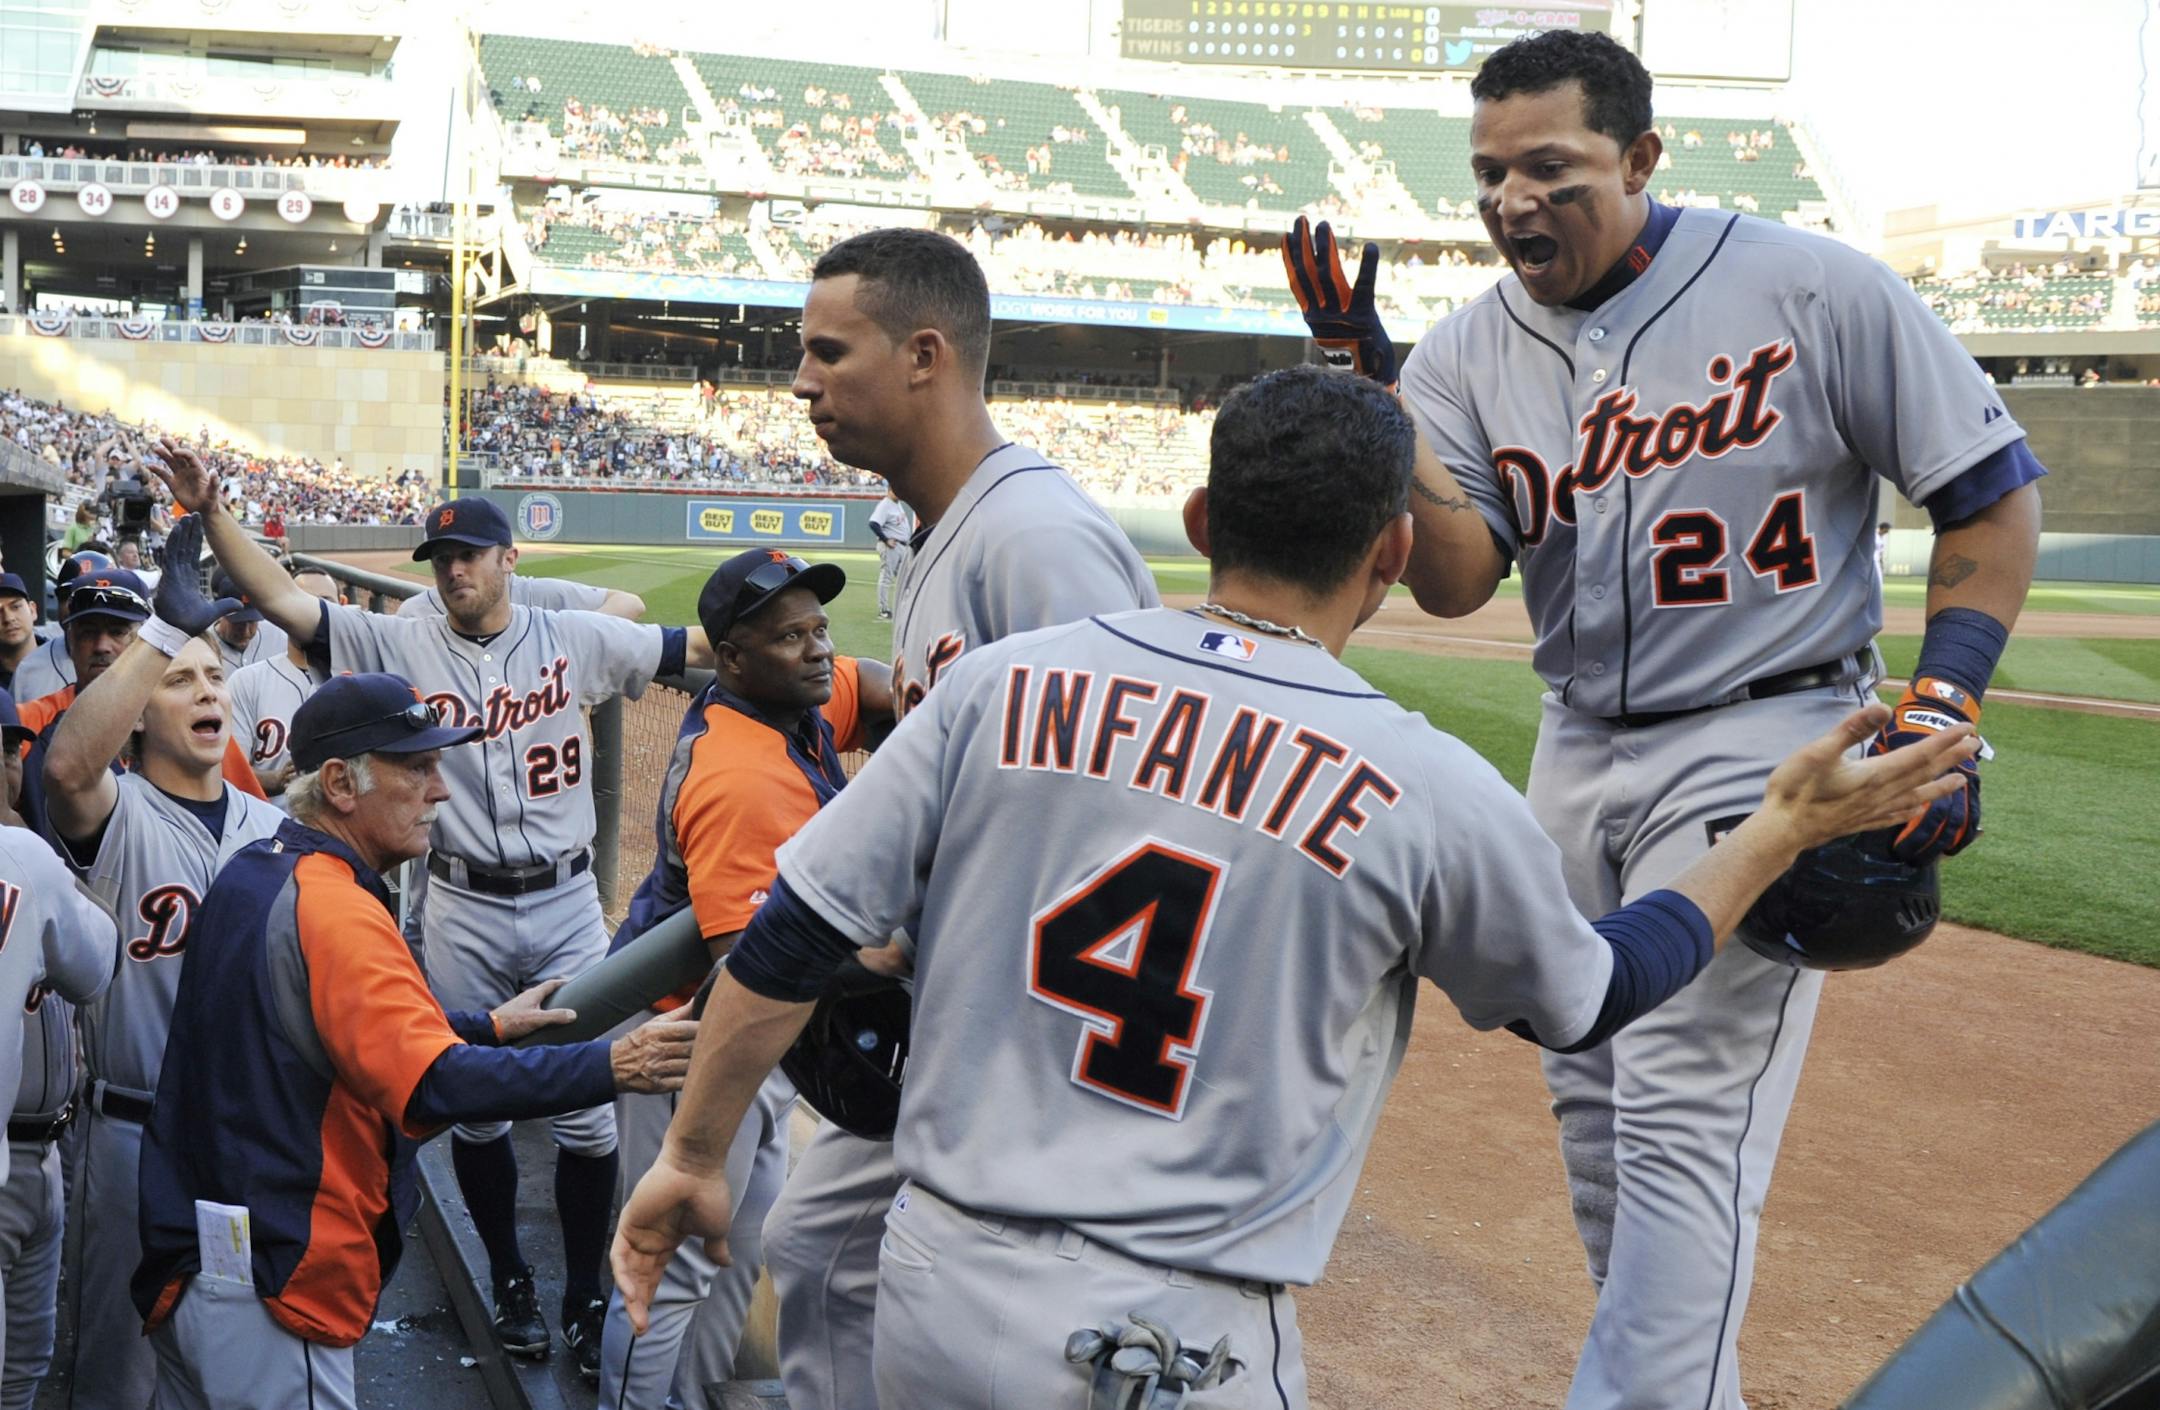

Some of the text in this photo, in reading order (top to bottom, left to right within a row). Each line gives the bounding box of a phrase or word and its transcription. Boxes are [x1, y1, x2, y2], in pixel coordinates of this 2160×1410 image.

[1192, 2, 1199, 16] 1
[1206, 2, 1217, 16] 2
[1222, 3, 1232, 16] 3
[1237, 3, 1248, 16] 4
[1254, 3, 1265, 17] 5
[1270, 4, 1281, 17] 6
[1286, 4, 1297, 18] 7
[1302, 4, 1314, 18] 8
[1318, 5, 1329, 18] 9
[1338, 5, 1349, 19] R
[1357, 6, 1368, 19] H
[1376, 6, 1386, 20] E
[1126, 18, 1404, 39] TIGERS 0 2 0 0 0 0 0 3 5 6 0 4
[1126, 39, 1402, 60] TWINS 0 0 0 0 0 0 0 0 4 1 6
[19, 189, 37, 203] 28
[86, 193, 104, 207] 34
[154, 195, 169, 209] 14
[286, 199, 303, 213] 29
[1031, 303, 1074, 318] WORK
[1077, 306, 1105, 320] FOR
[1108, 307, 1138, 321] YOU
[705, 512, 731, 521] BEST
[755, 514, 781, 523] BEST
[804, 515, 830, 525] BEST
[705, 520, 728, 529] BUY
[755, 522, 778, 530] BUY
[804, 523, 827, 532] BUY
[1649, 488, 1821, 608] 24
[525, 735, 582, 800] 29
[998, 664, 1403, 880] INFANTE
[1026, 835, 1230, 1122] 4
